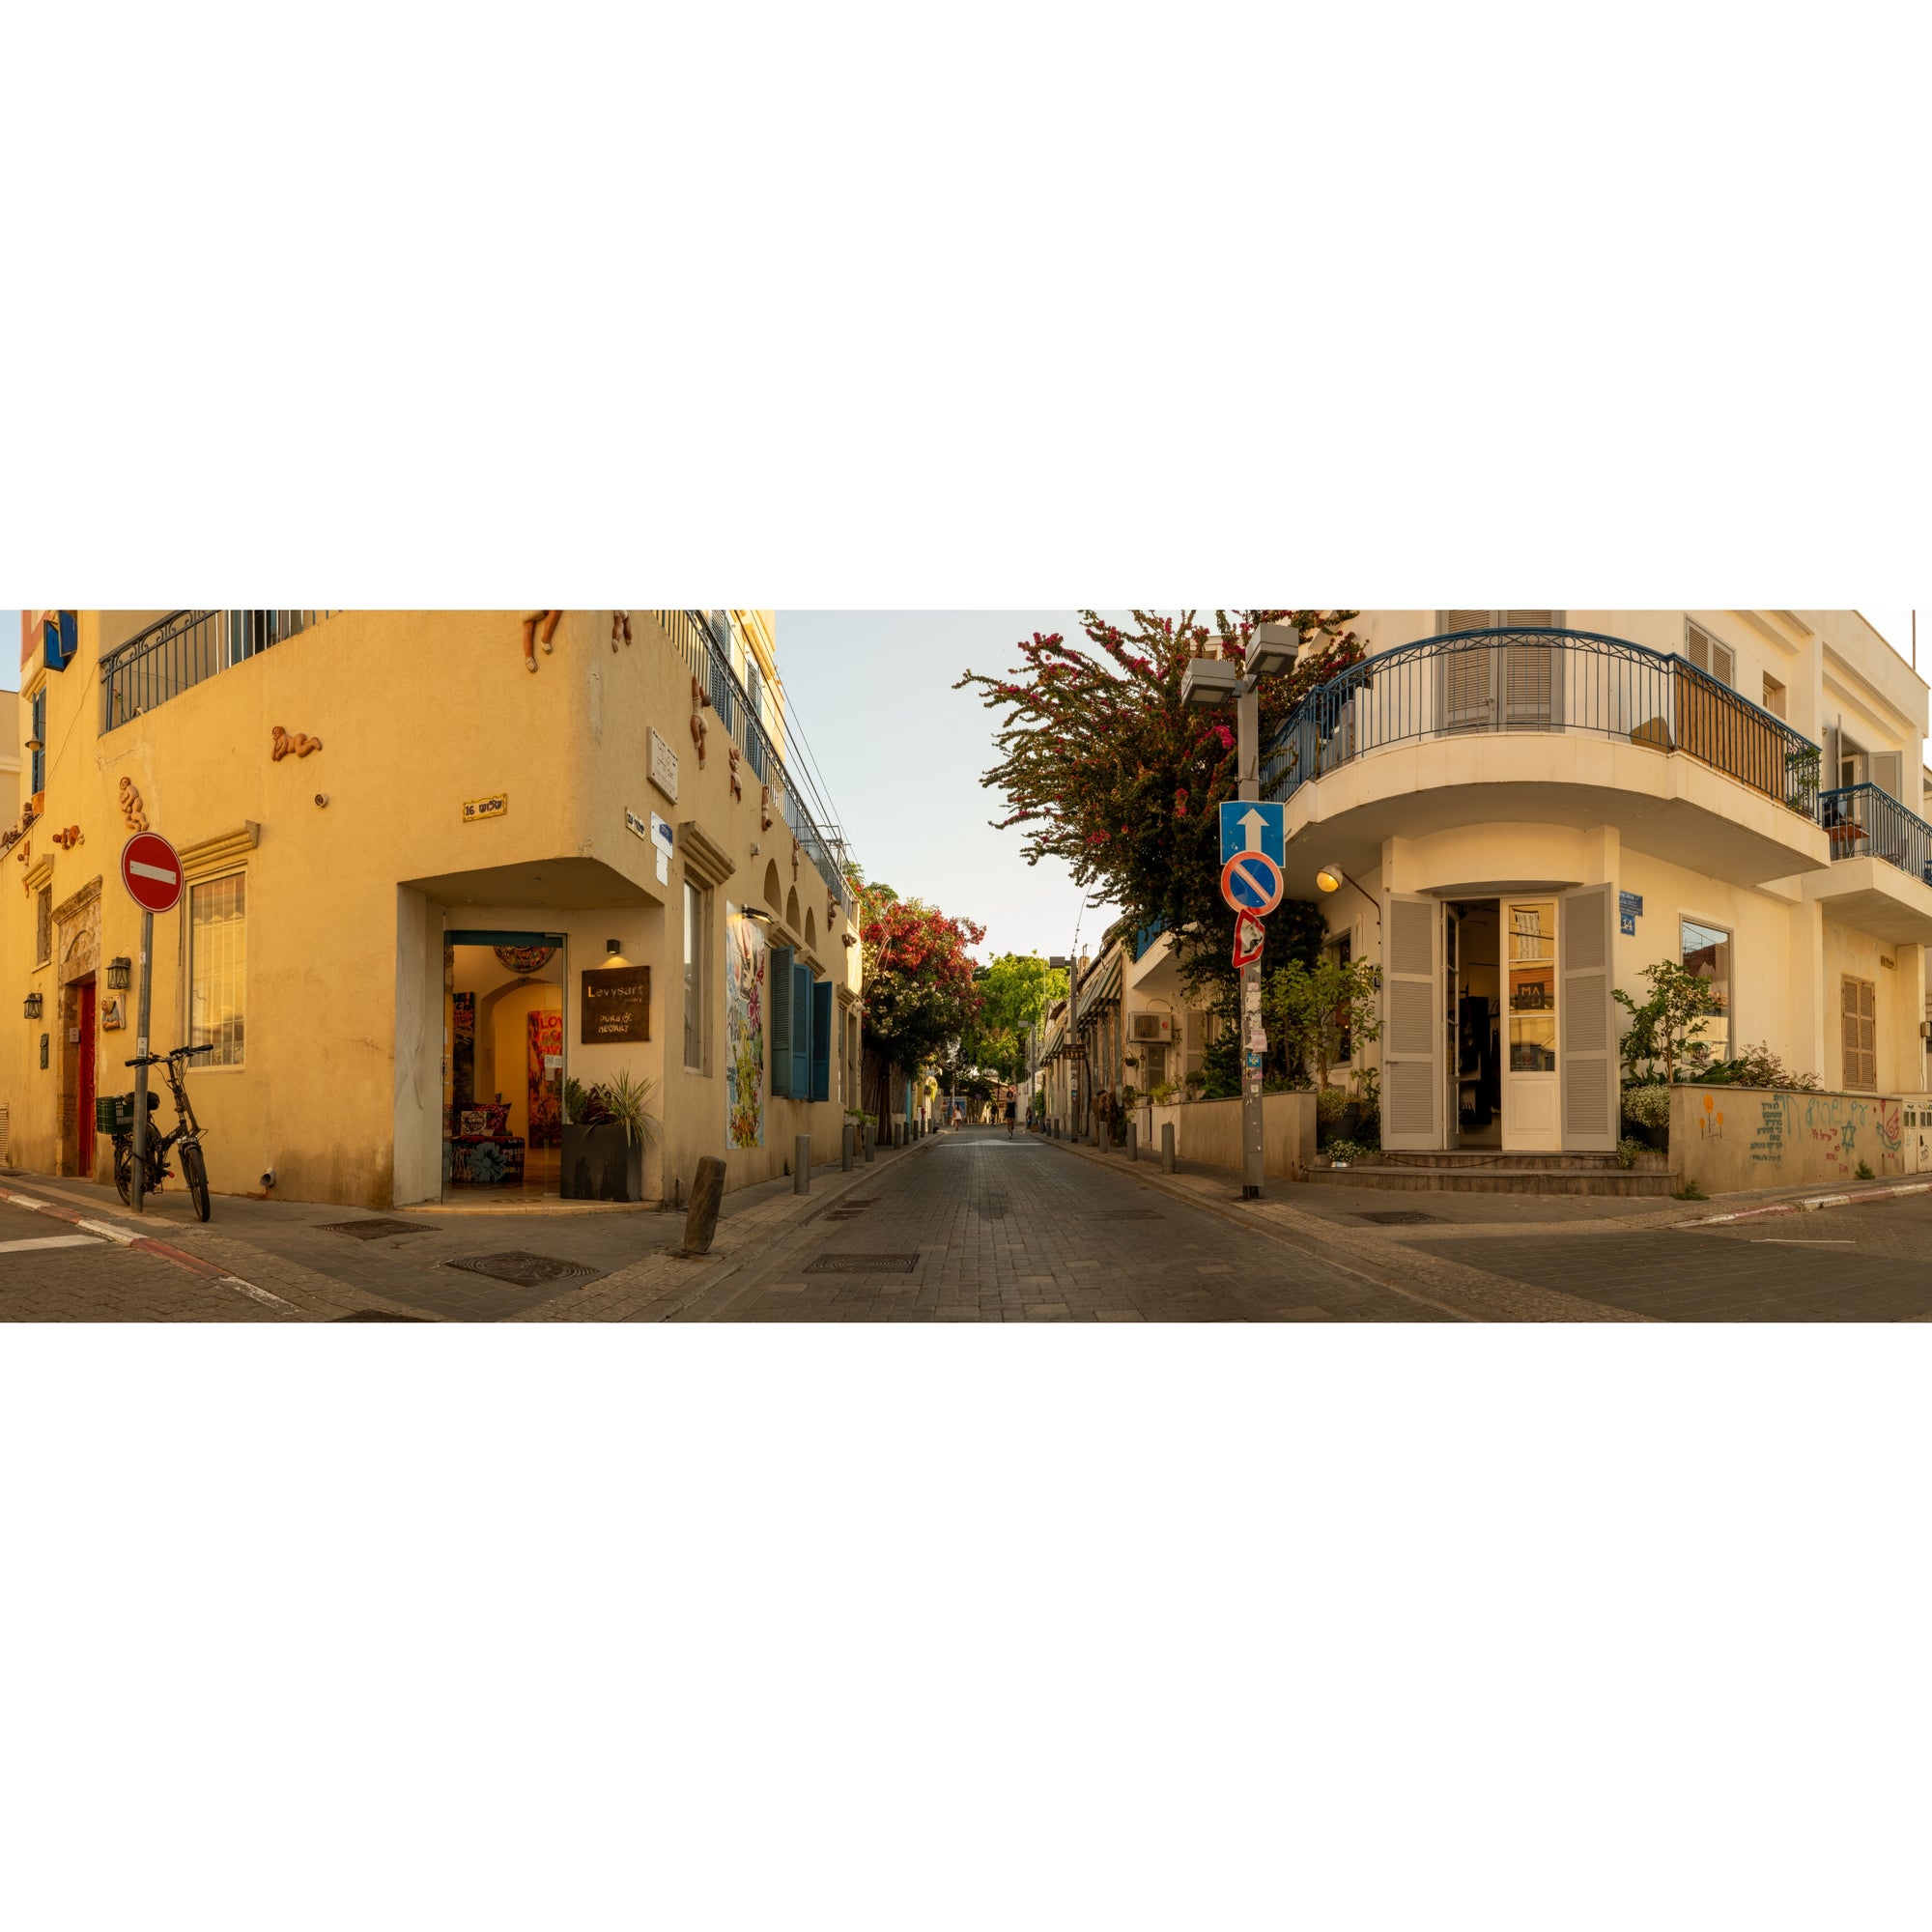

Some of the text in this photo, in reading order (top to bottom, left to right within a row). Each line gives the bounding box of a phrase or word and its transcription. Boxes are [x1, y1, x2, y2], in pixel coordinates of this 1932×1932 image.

[465, 806, 474, 815] 16
[587, 985, 644, 998] Levysart
[1521, 986, 1540, 996] MA
